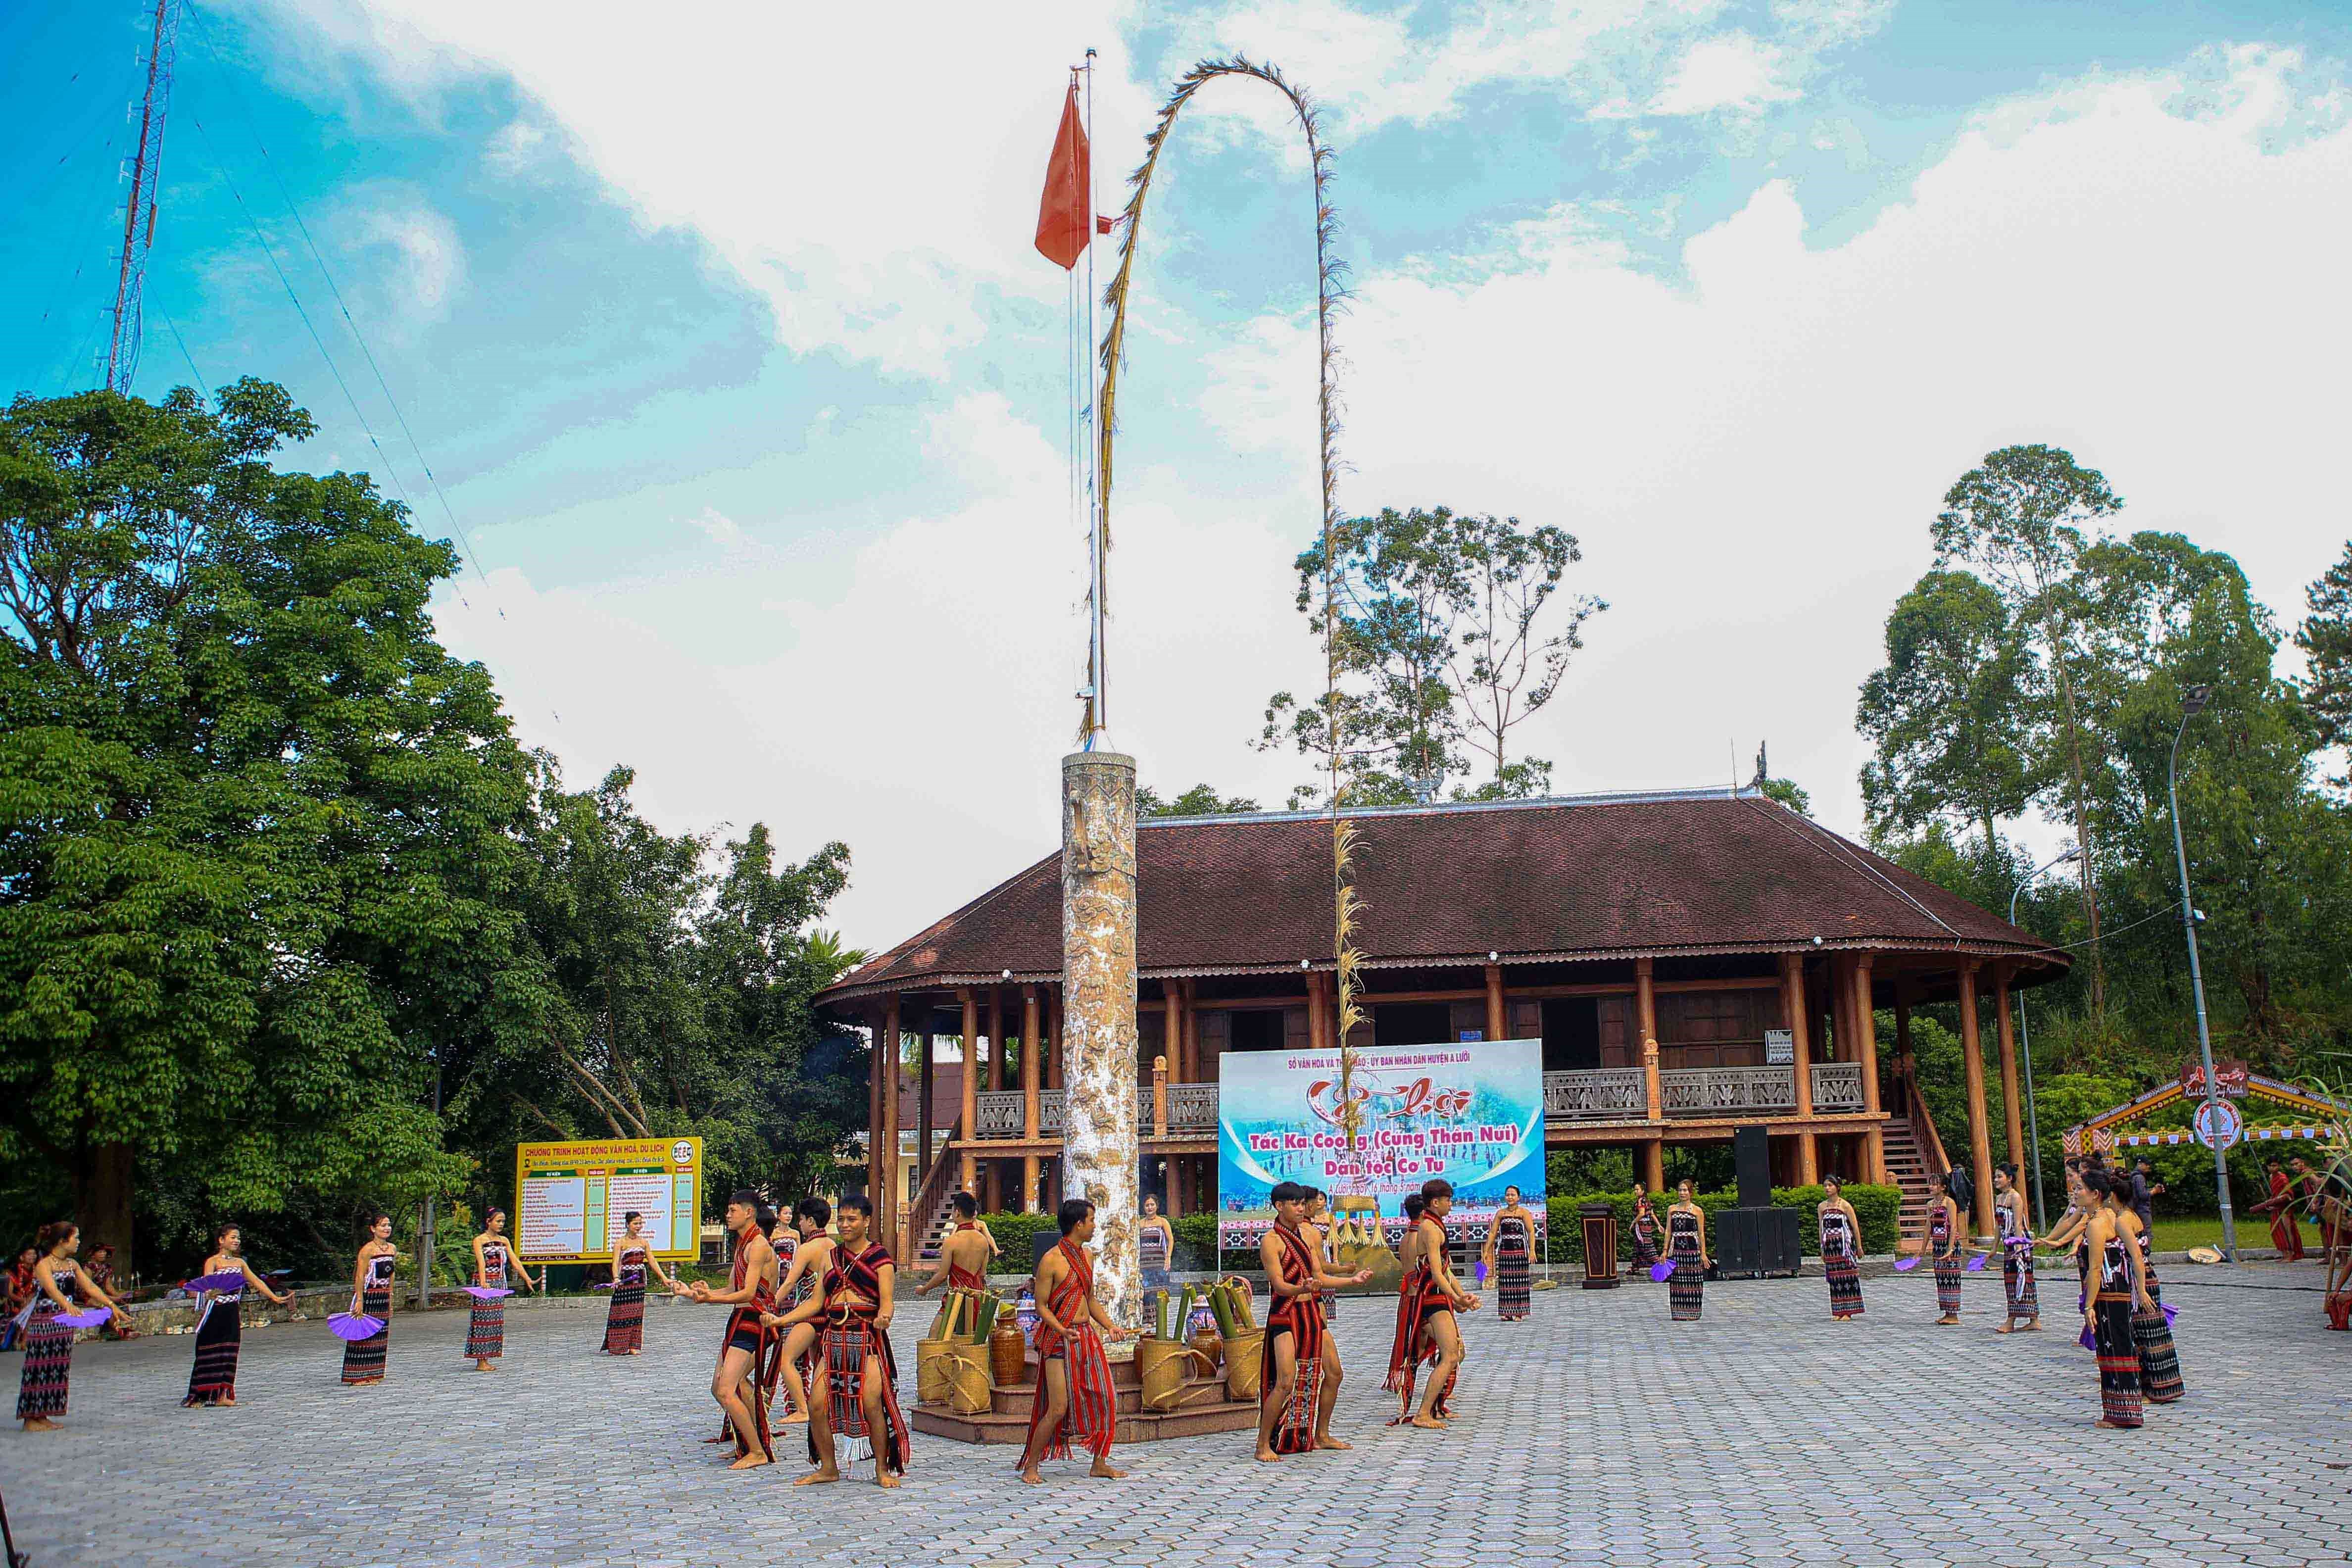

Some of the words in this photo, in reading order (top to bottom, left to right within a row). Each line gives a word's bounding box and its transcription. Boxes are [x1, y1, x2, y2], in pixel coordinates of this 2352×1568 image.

[1381, 1056, 1393, 1066] BAN
[1395, 1054, 1412, 1065] NHÂN
[1427, 1052, 1448, 1066] HUYỆN
[1450, 1053, 1455, 1062] A
[1285, 1133, 1307, 1149] Ka
[640, 1145, 649, 1153] DU
[1366, 1160, 1391, 1178] tộc
[1398, 1158, 1420, 1173] Cơ
[1425, 1157, 1444, 1172] Tu
